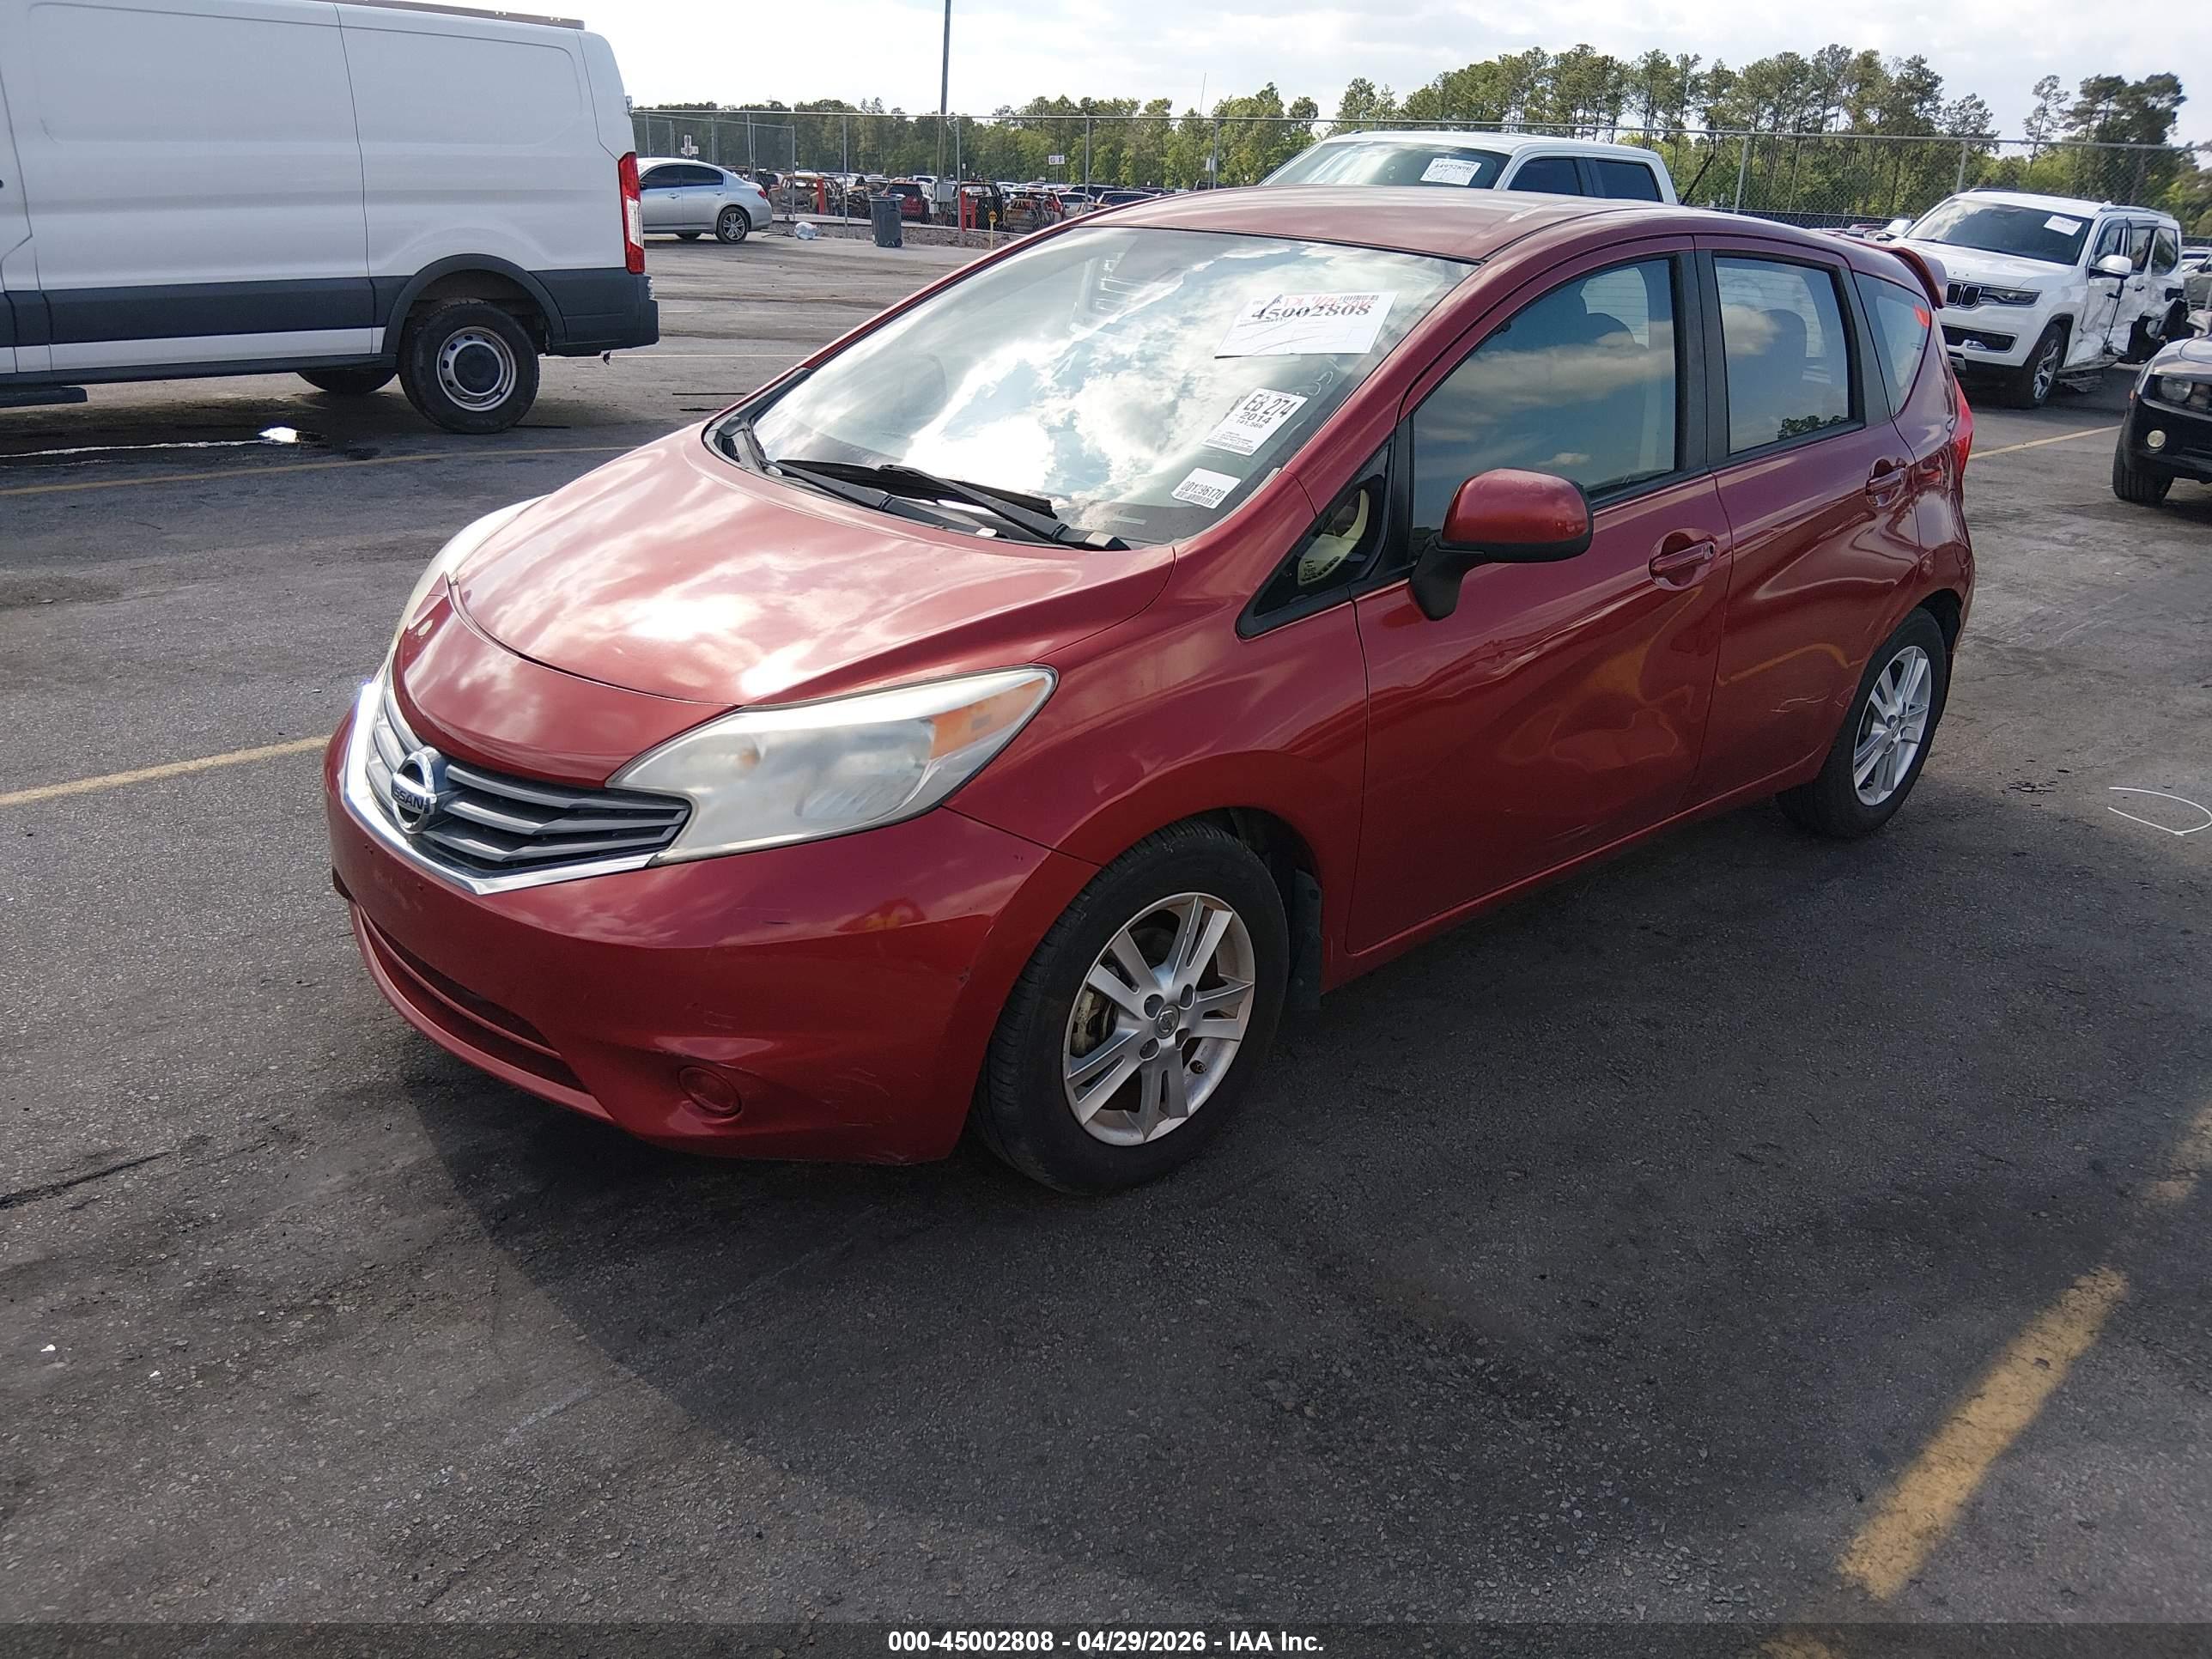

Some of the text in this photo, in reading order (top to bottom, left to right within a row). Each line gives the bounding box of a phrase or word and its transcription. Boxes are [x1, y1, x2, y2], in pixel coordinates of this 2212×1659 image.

[1251, 303, 1372, 319] 45002808
[1262, 398, 1297, 418] 274
[1239, 411, 1272, 424] 2014
